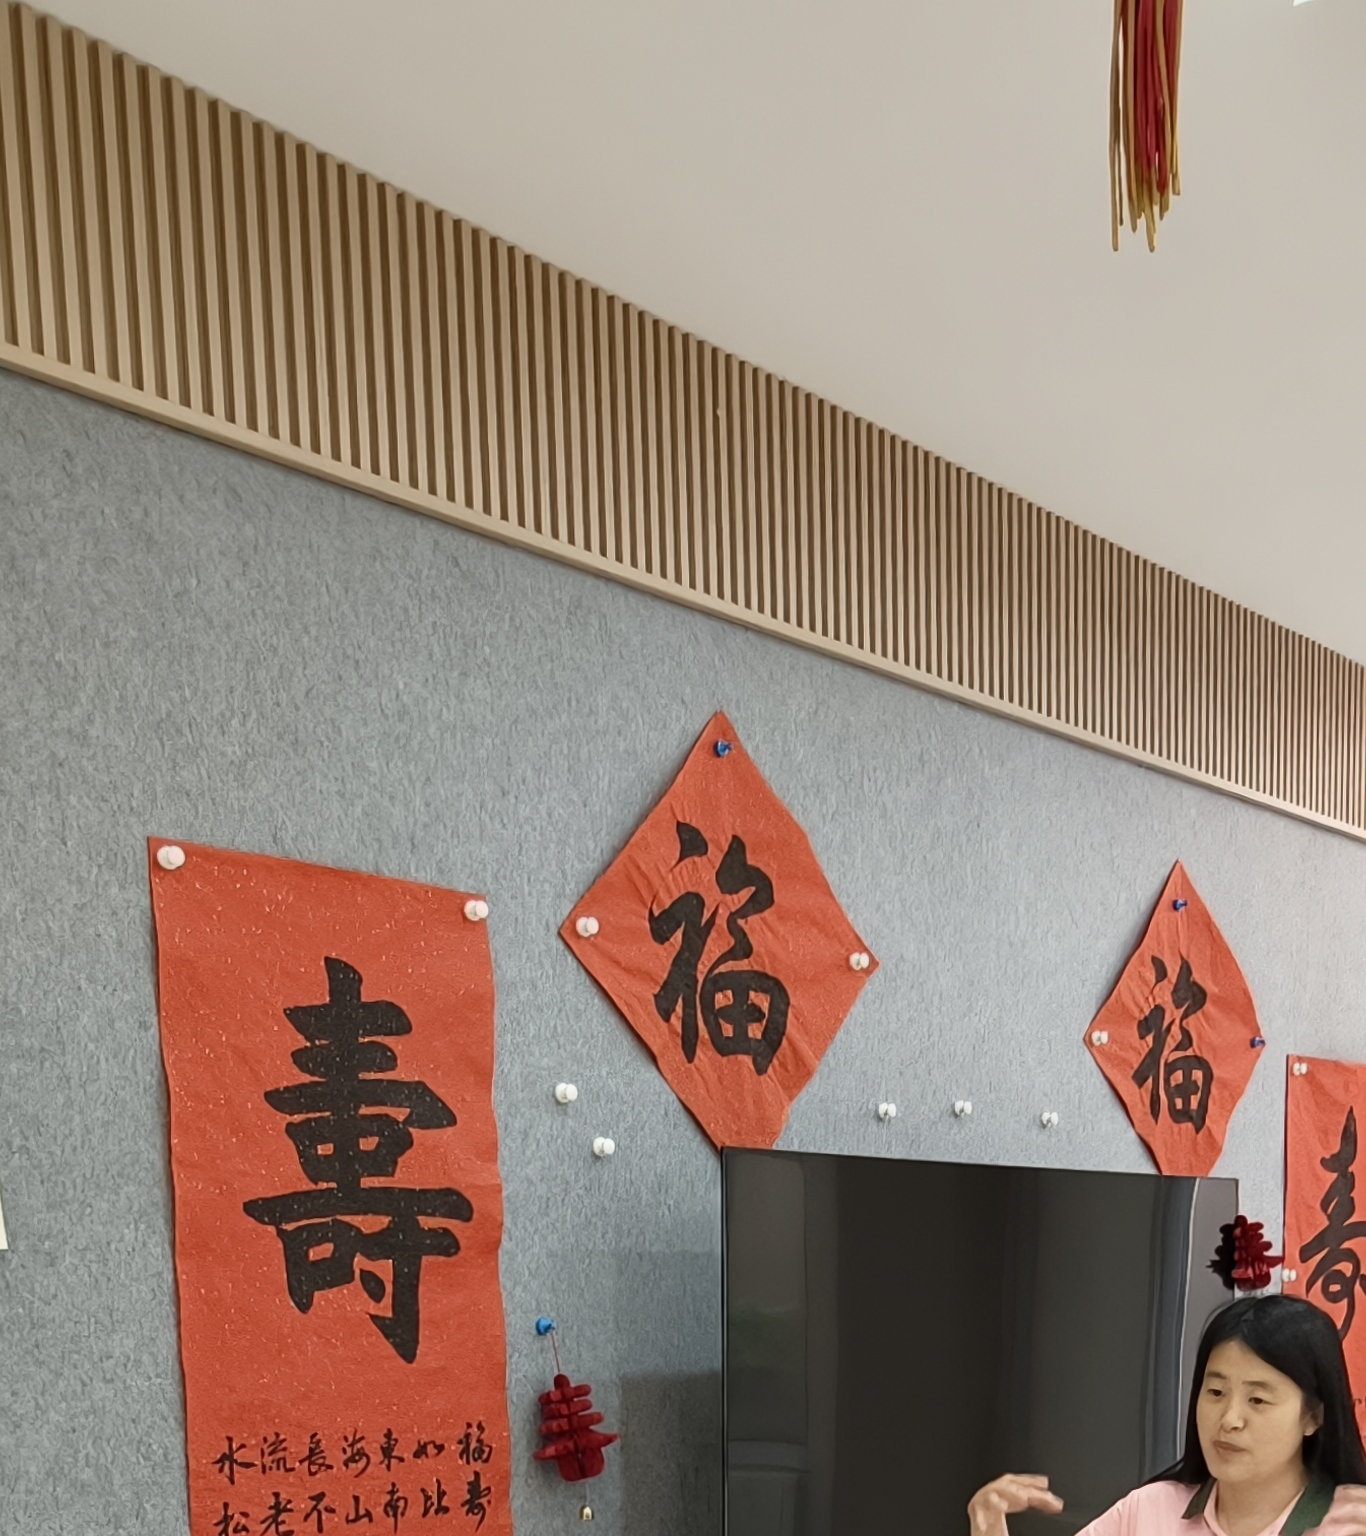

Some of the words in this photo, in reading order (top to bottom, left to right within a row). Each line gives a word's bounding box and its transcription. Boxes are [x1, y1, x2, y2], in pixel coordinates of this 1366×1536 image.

[647, 820, 791, 1076] 福
[1131, 956, 1214, 1135] 福
[243, 956, 474, 1364] 壽
